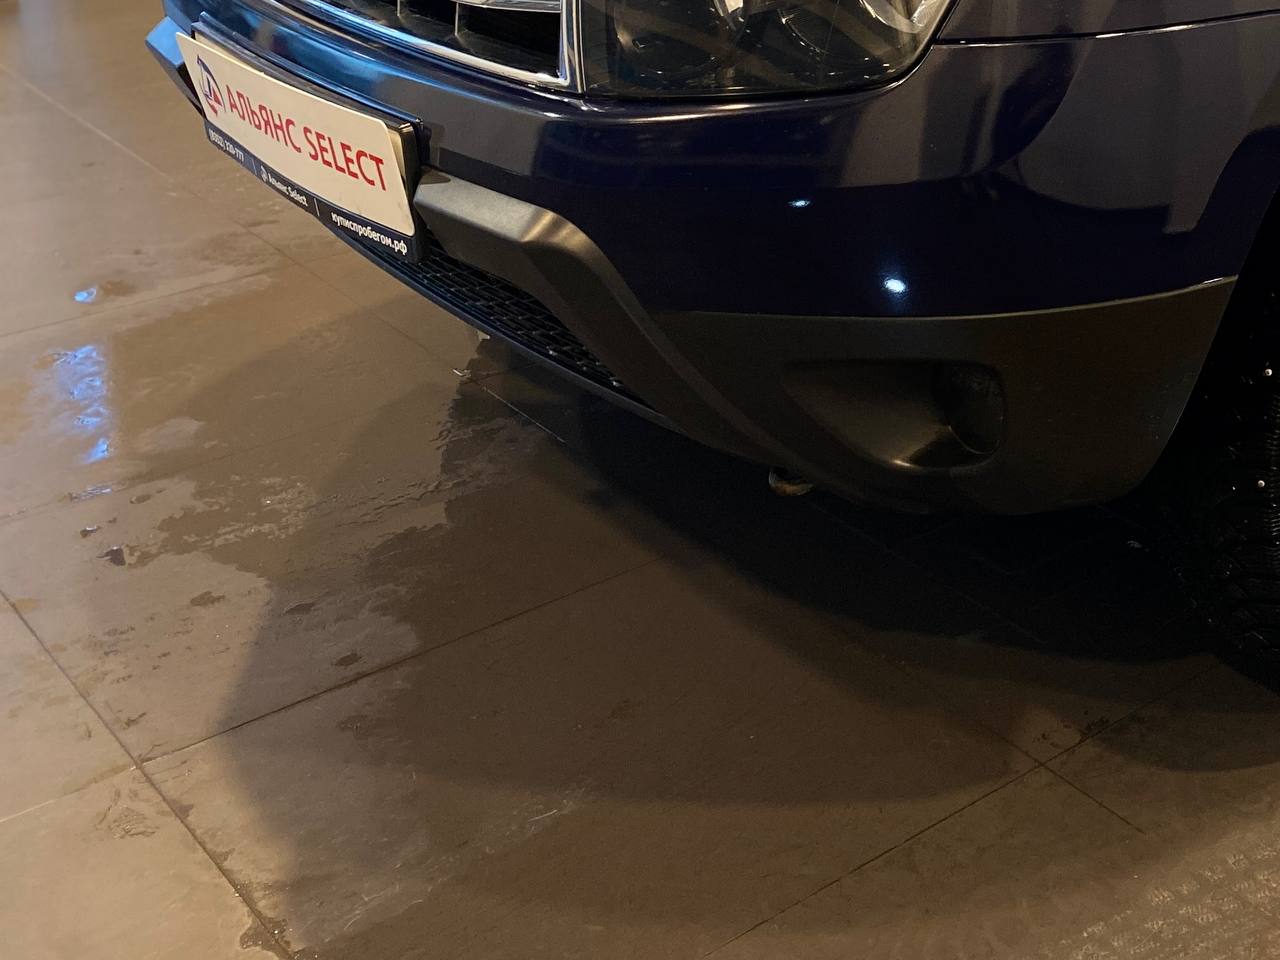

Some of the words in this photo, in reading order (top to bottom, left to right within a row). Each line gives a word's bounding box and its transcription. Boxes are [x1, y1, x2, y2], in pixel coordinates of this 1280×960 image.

[226, 84, 302, 154] АЛЬЯНС
[303, 126, 387, 192] SELECT
[330, 212, 408, 256] куписпробегом.рф
